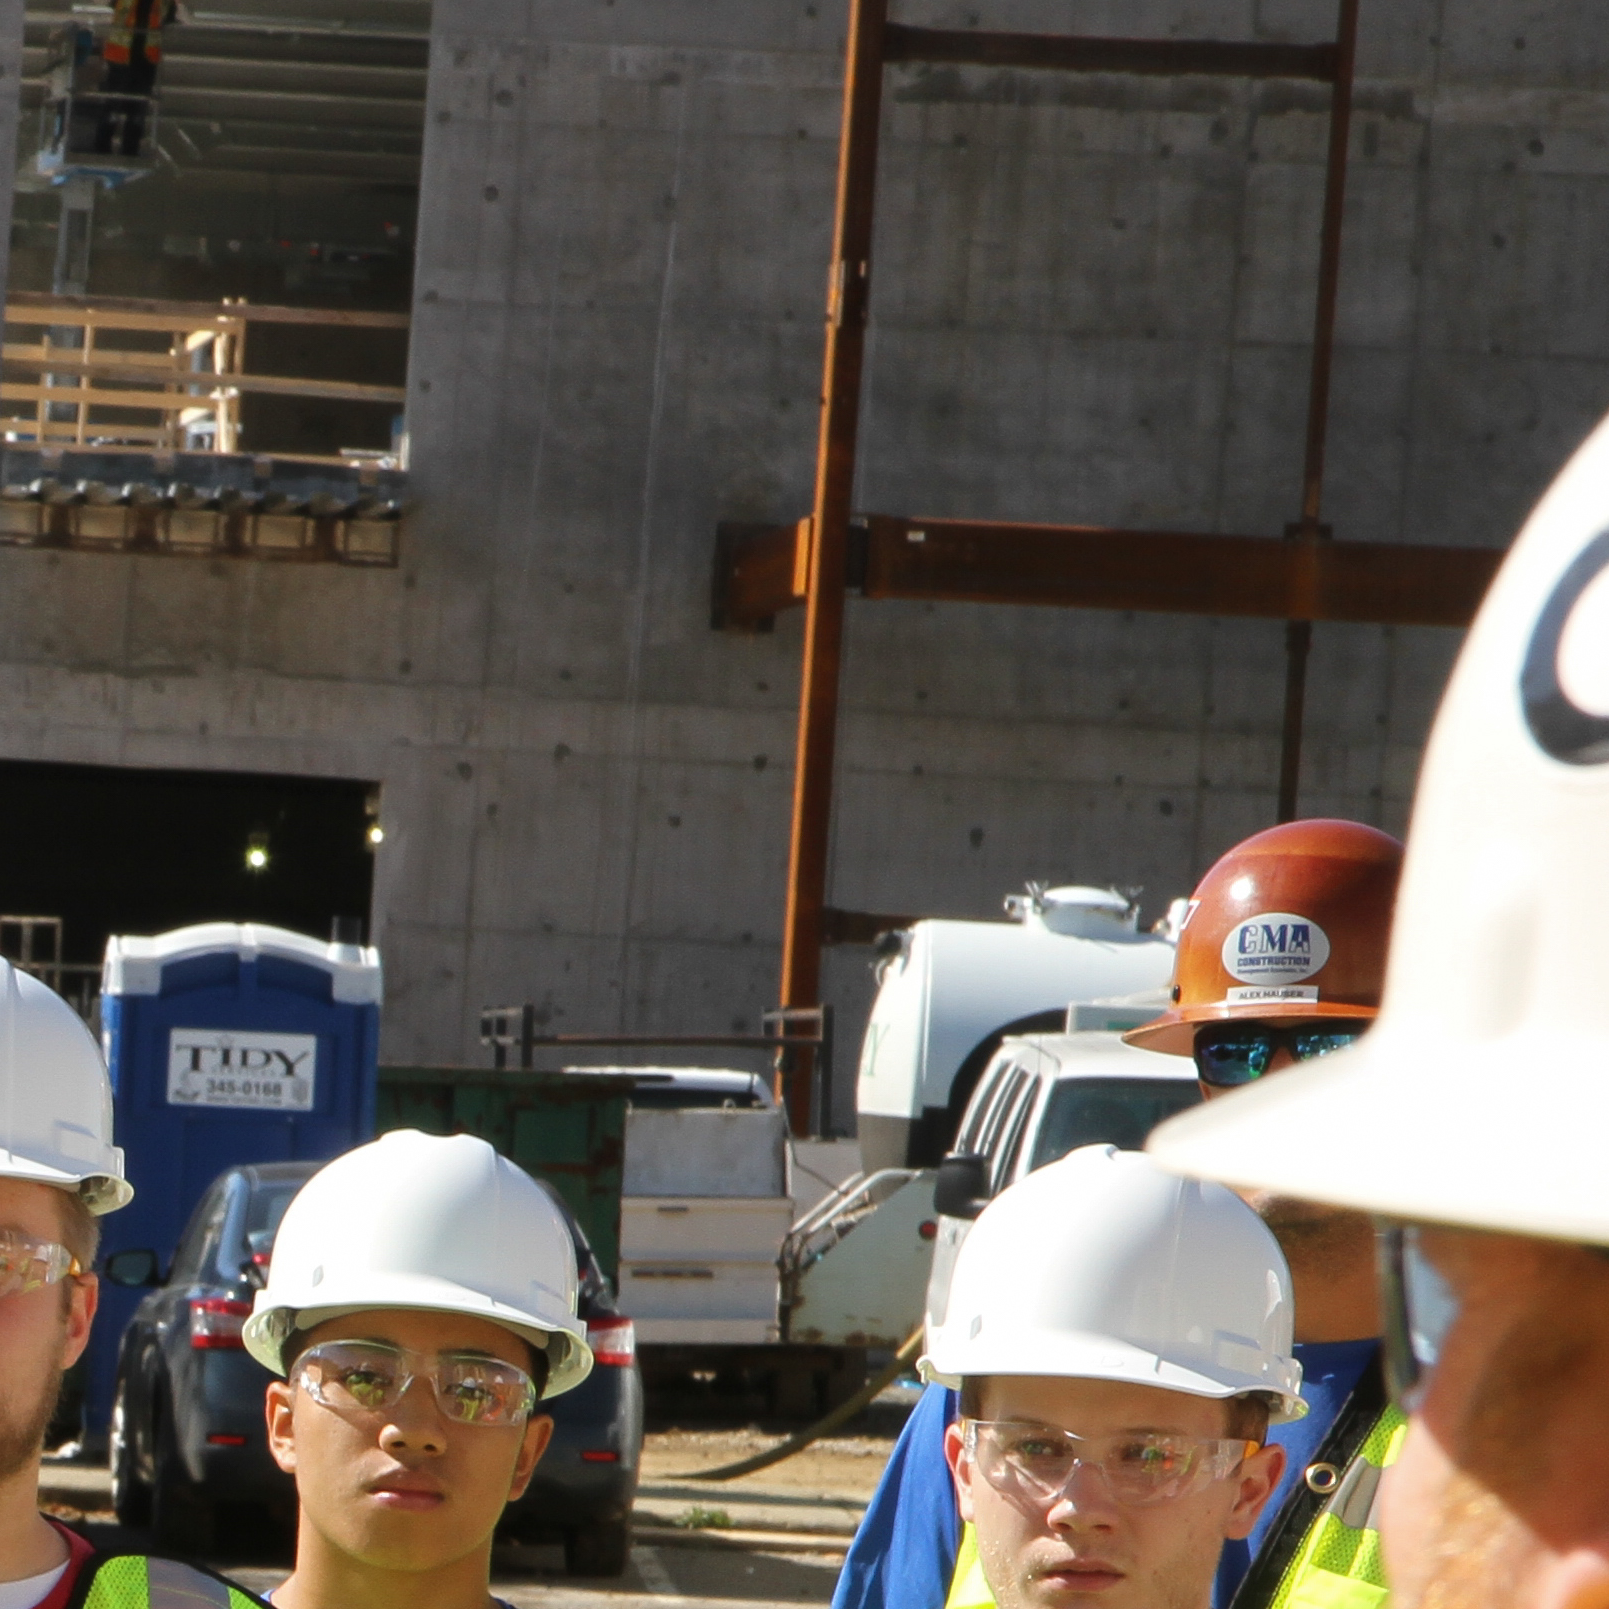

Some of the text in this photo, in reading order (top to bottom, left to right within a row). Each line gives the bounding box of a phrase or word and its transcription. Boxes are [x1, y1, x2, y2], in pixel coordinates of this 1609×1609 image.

[1237, 923, 1312, 955] CMA
[1237, 955, 1311, 967] CONSTRUCTION
[1239, 989, 1262, 1000] ALEX
[174, 1044, 310, 1078] TIDY
